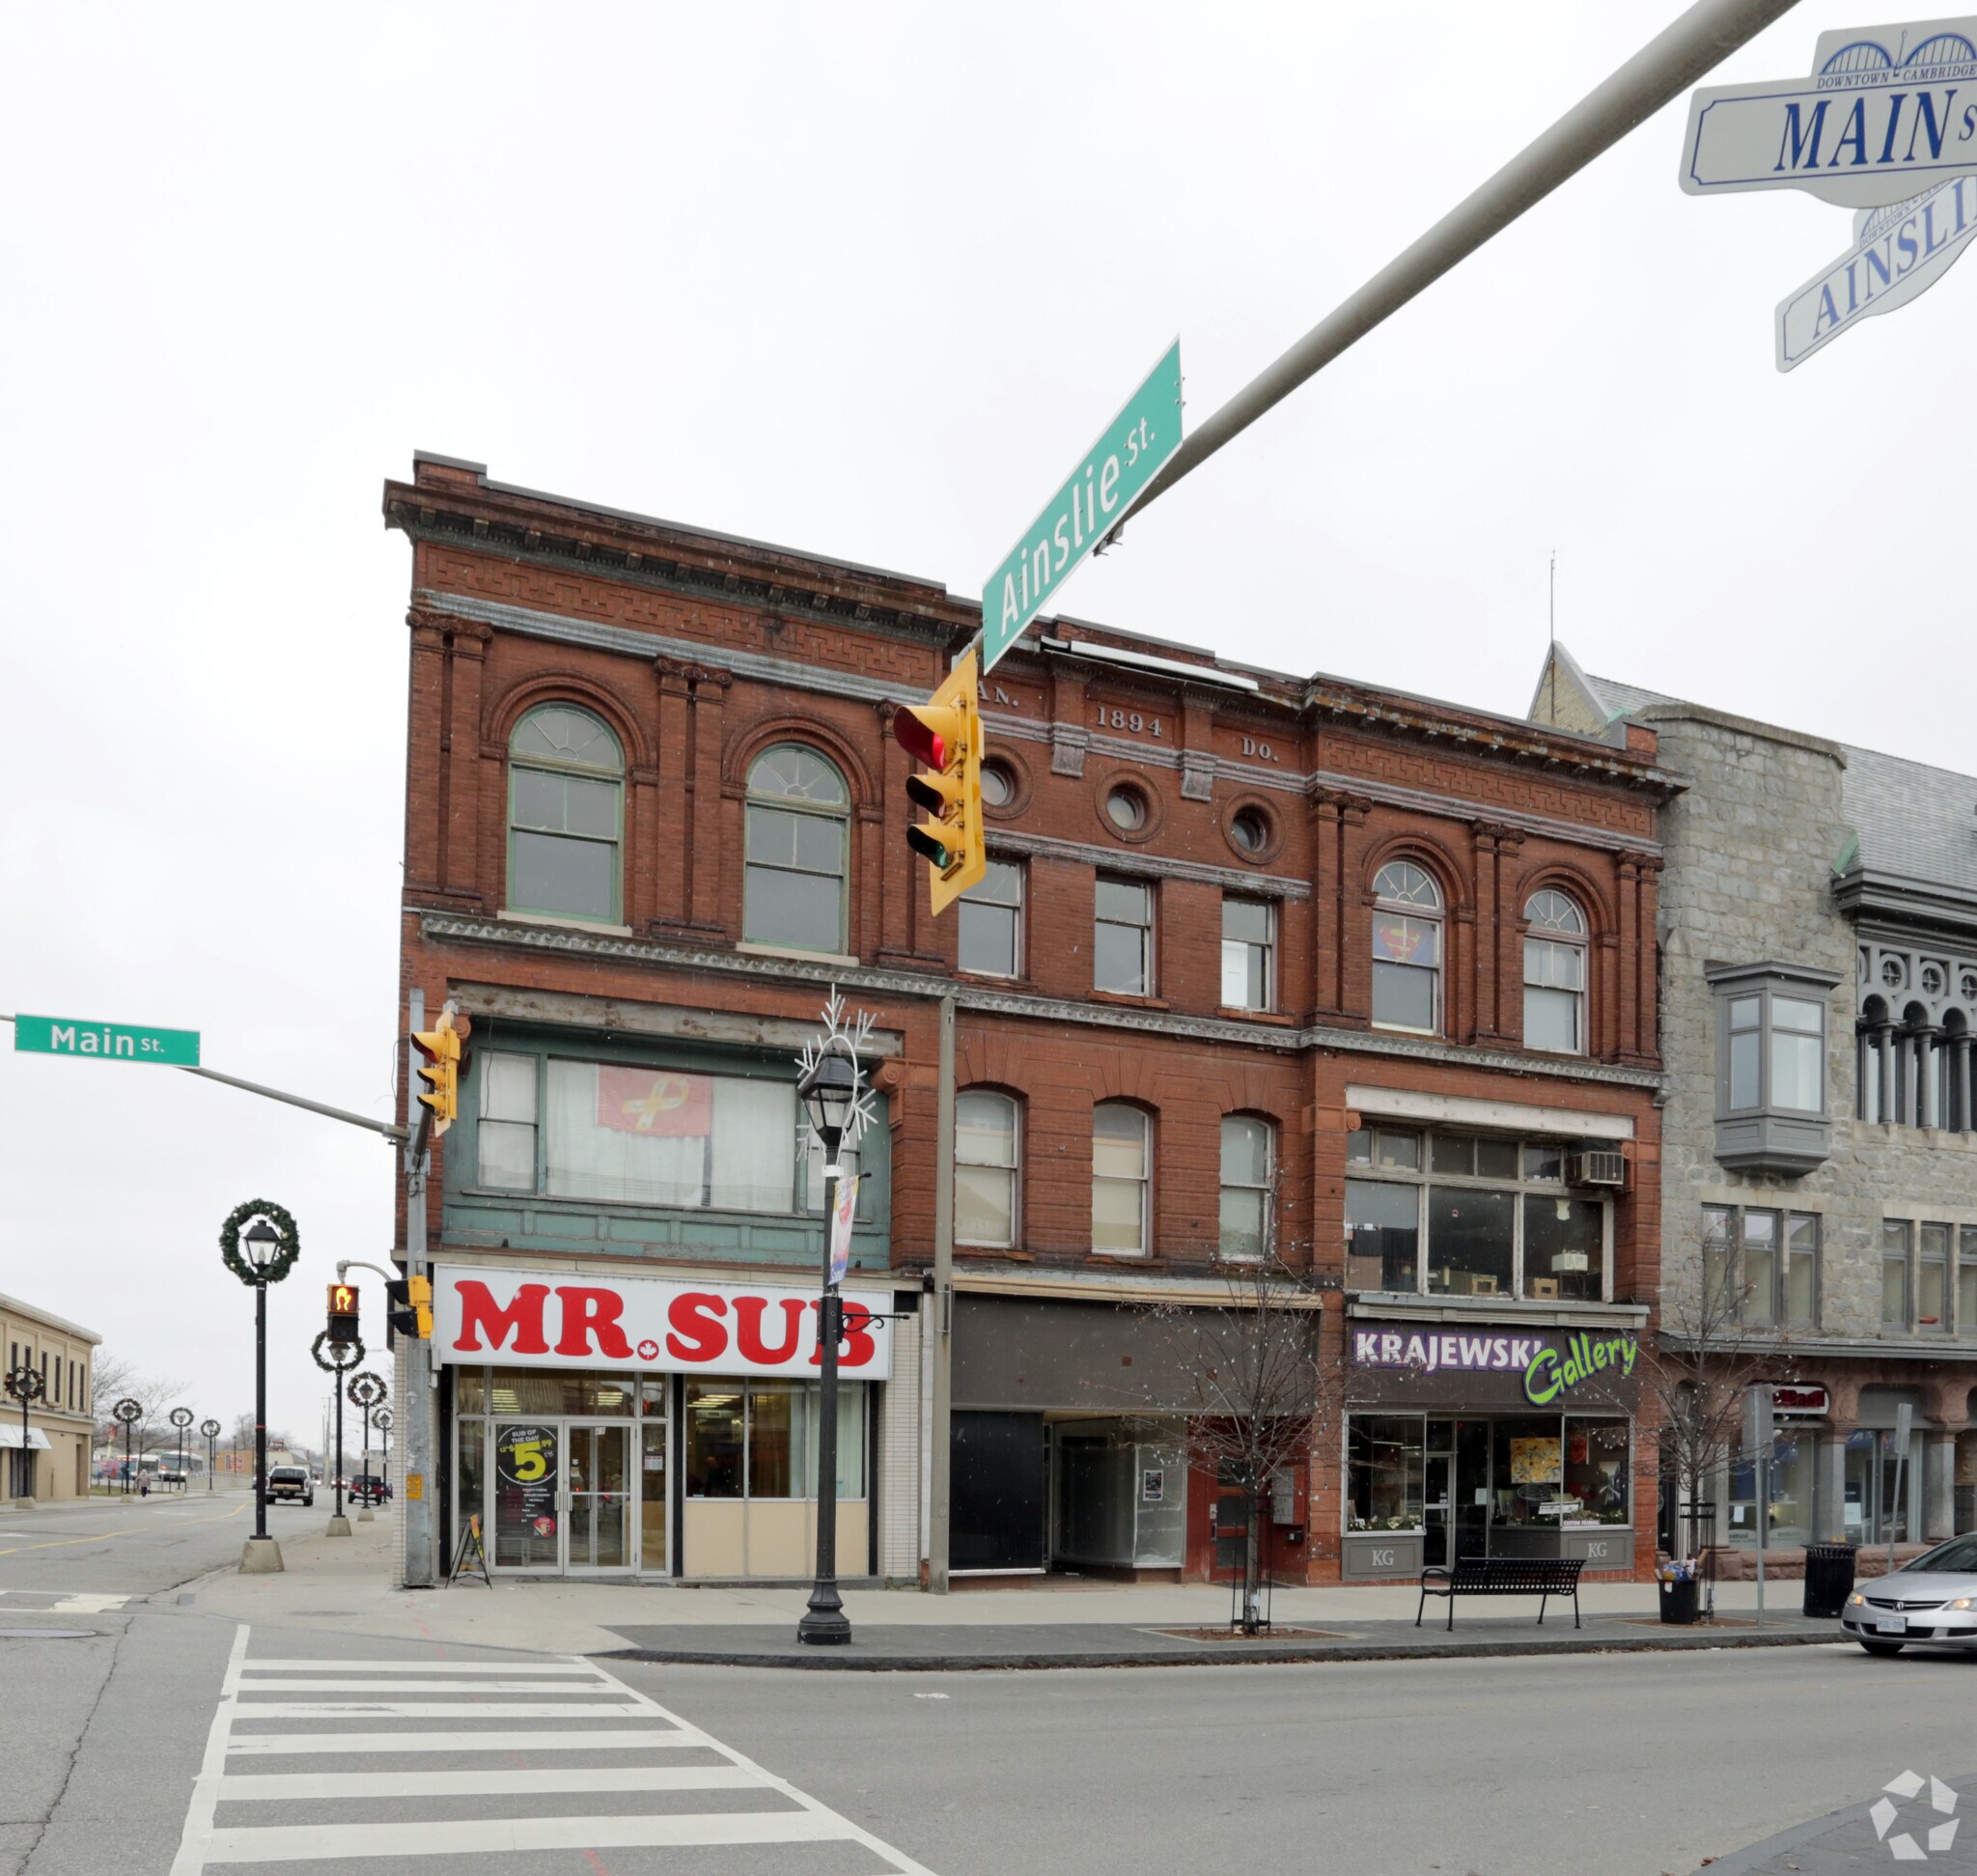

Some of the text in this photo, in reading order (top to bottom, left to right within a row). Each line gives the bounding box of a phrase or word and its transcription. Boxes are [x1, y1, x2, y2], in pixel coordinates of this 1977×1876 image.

[1817, 71, 1890, 89] DOWNTOWN
[1773, 89, 1958, 172] MAIN
[1812, 176, 1977, 340] AINSLI
[1000, 455, 1121, 637] Ainslie
[1097, 706, 1162, 737] 1894
[51, 1024, 135, 1056] Main
[1524, 1331, 1637, 1405] Gallery
[1371, 1550, 1395, 1566] KG
[1588, 1542, 1607, 1558] KG
